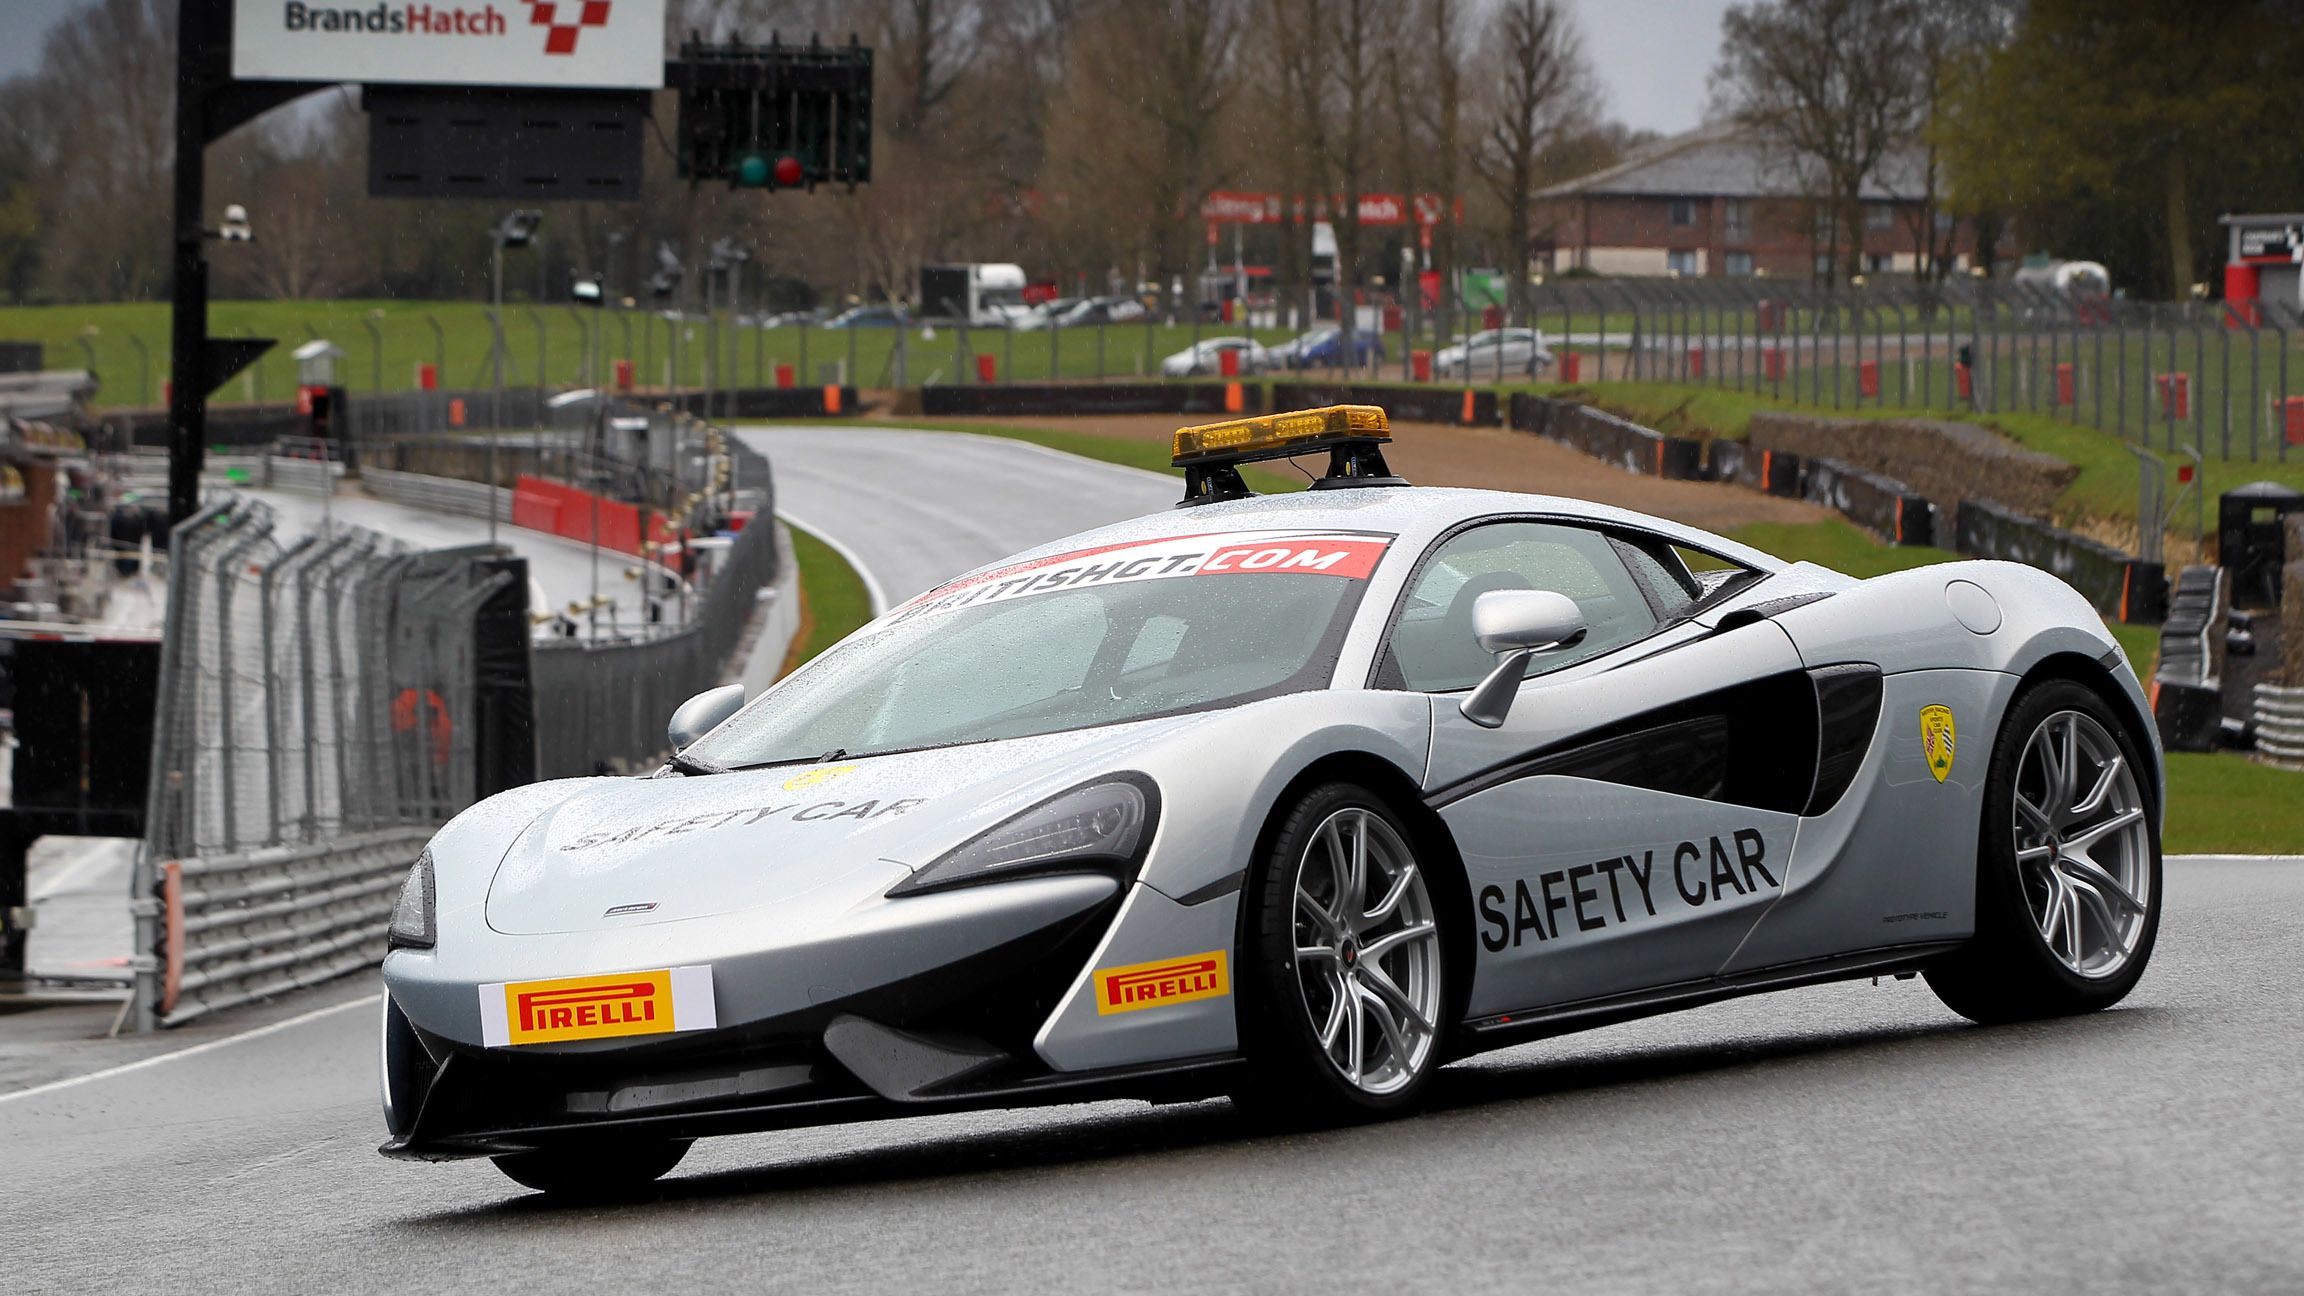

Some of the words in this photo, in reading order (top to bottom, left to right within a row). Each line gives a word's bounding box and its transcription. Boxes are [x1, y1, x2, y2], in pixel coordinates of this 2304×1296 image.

[284, 0, 508, 36] BrandsHatch
[1478, 850, 1657, 953] SAFETY
[1673, 827, 1781, 907] CAR
[1106, 959, 1217, 1006] PIRELLI
[517, 982, 655, 1032] PIRELLI
